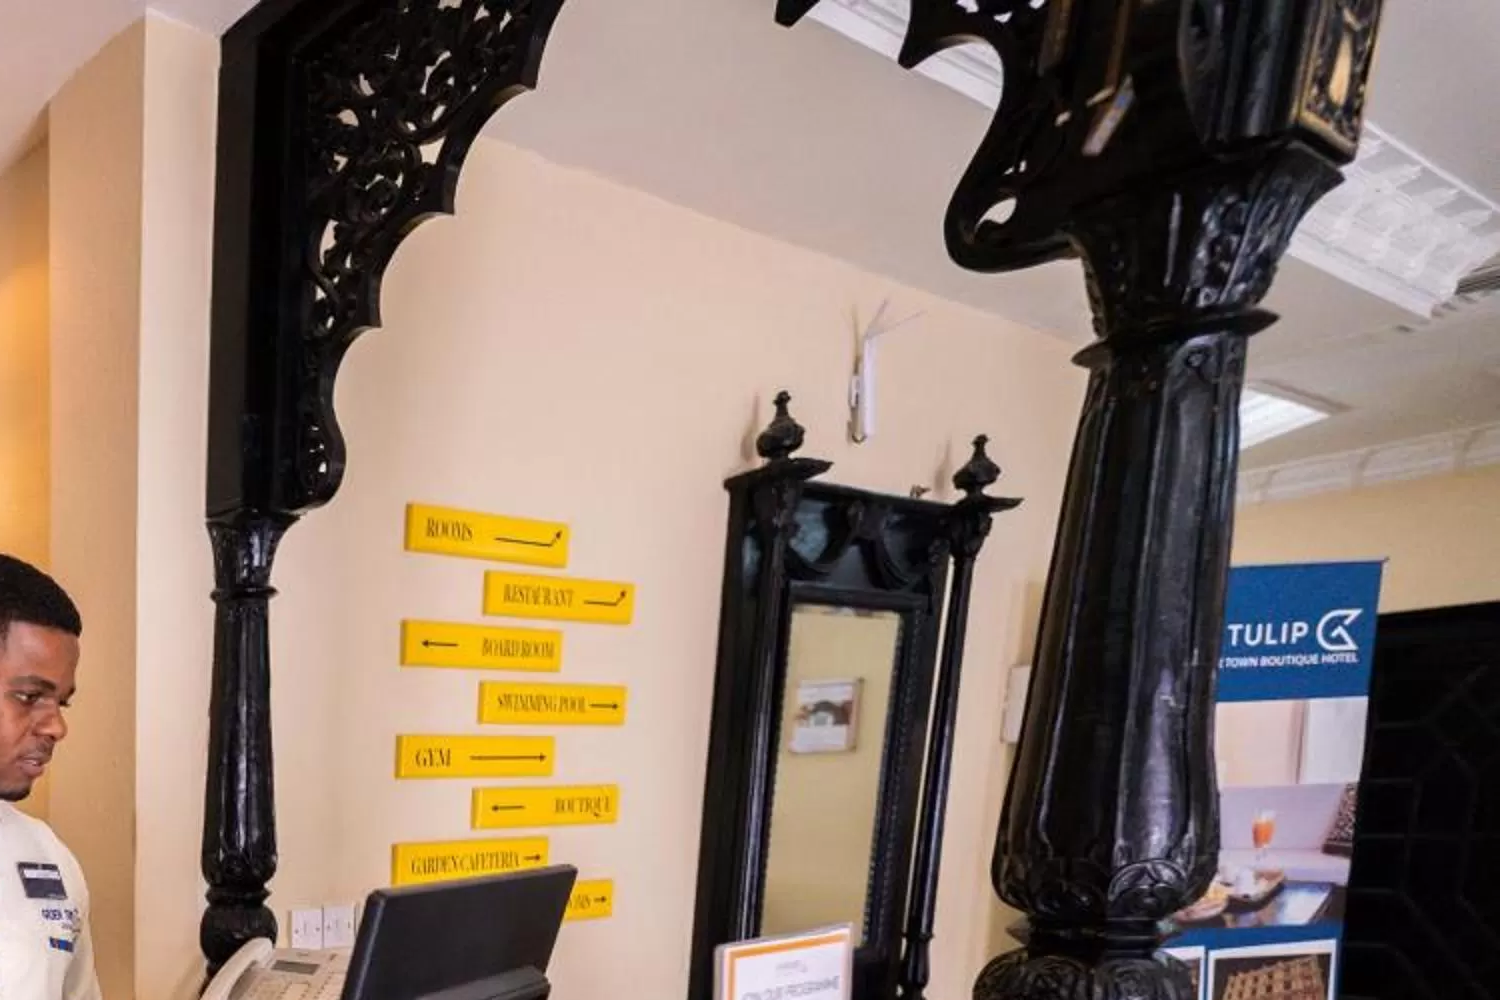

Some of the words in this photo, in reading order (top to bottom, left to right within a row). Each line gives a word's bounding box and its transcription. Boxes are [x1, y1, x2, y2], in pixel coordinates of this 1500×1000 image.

[1228, 622, 1309, 646] TULIP
[1226, 656, 1259, 668] TOWN
[1260, 653, 1319, 667] BOUTIQUE
[1321, 652, 1358, 664] HOTEL
[415, 747, 451, 768] GYM
